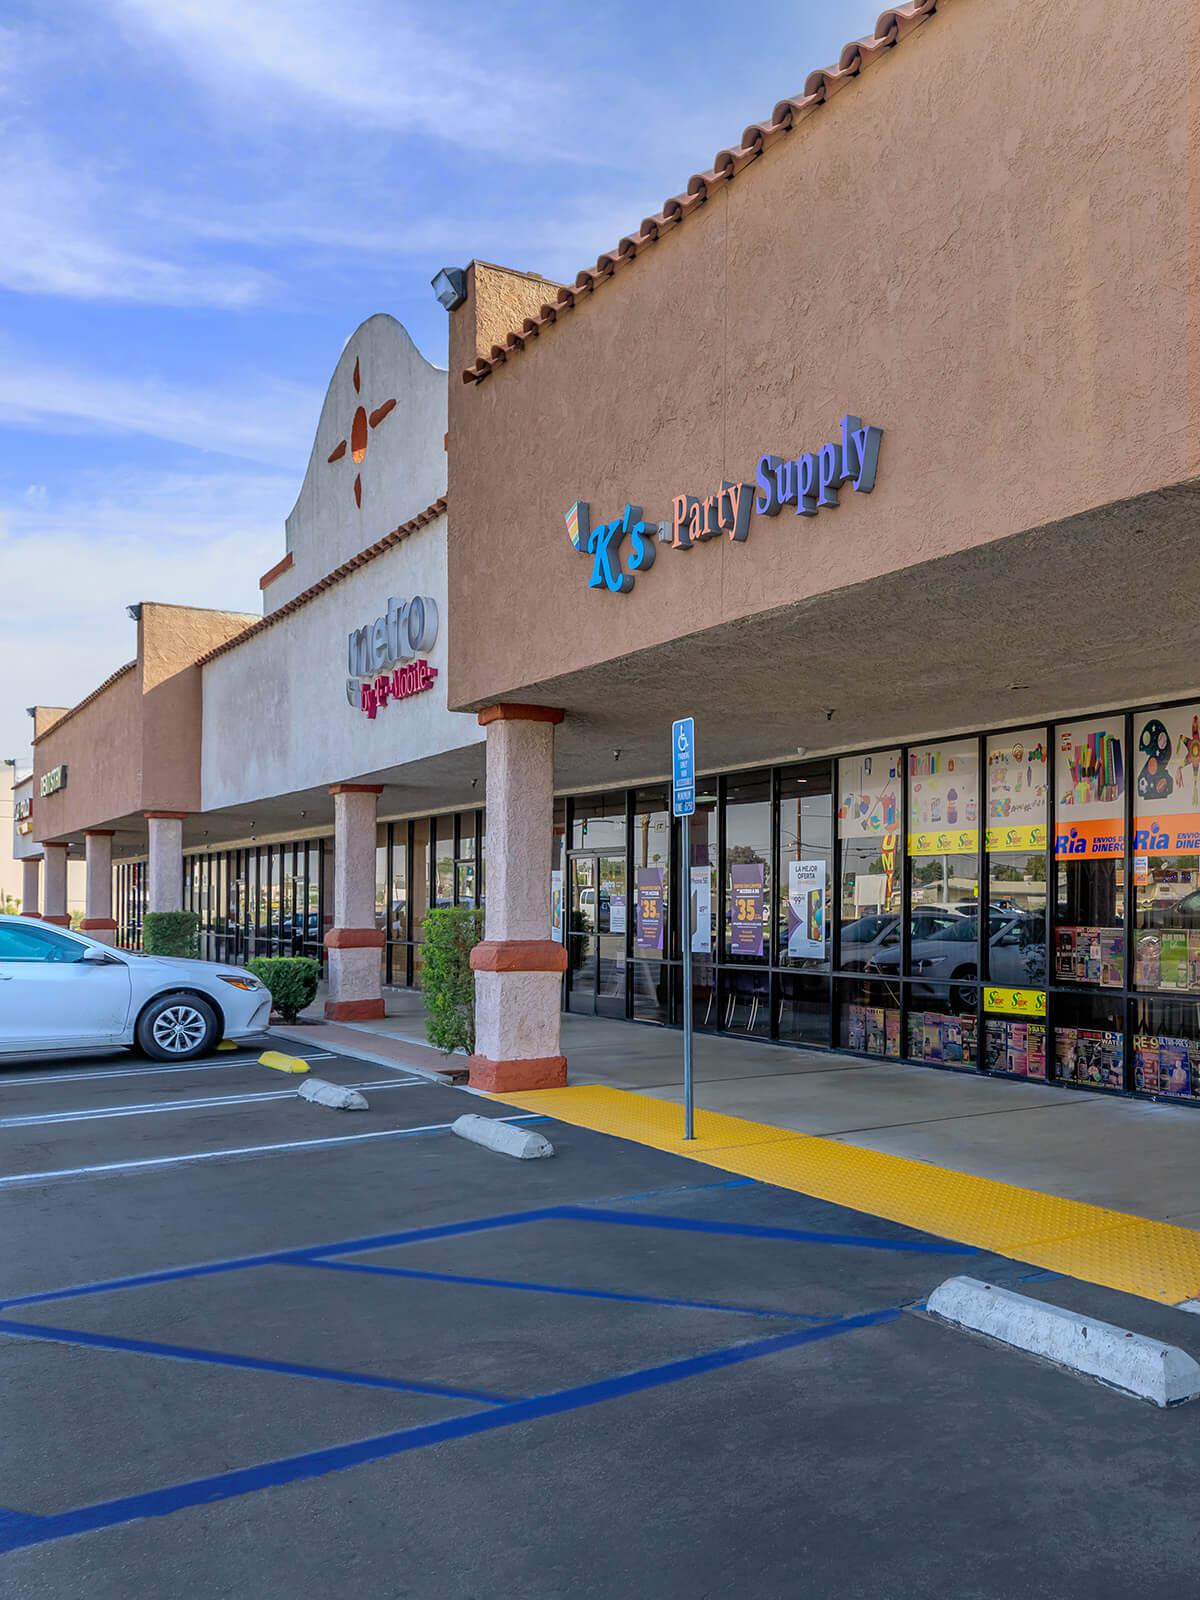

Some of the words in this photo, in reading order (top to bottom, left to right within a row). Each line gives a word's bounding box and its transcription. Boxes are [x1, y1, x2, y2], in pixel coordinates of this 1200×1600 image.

[587, 503, 651, 593] K's
[671, 479, 750, 550] Party
[756, 415, 882, 517] Supply
[348, 596, 438, 677] metro
[1055, 828, 1086, 854] Ria
[1133, 822, 1170, 850] Ria
[797, 872, 816, 880] OFERTA
[802, 865, 818, 873] MEJOR
